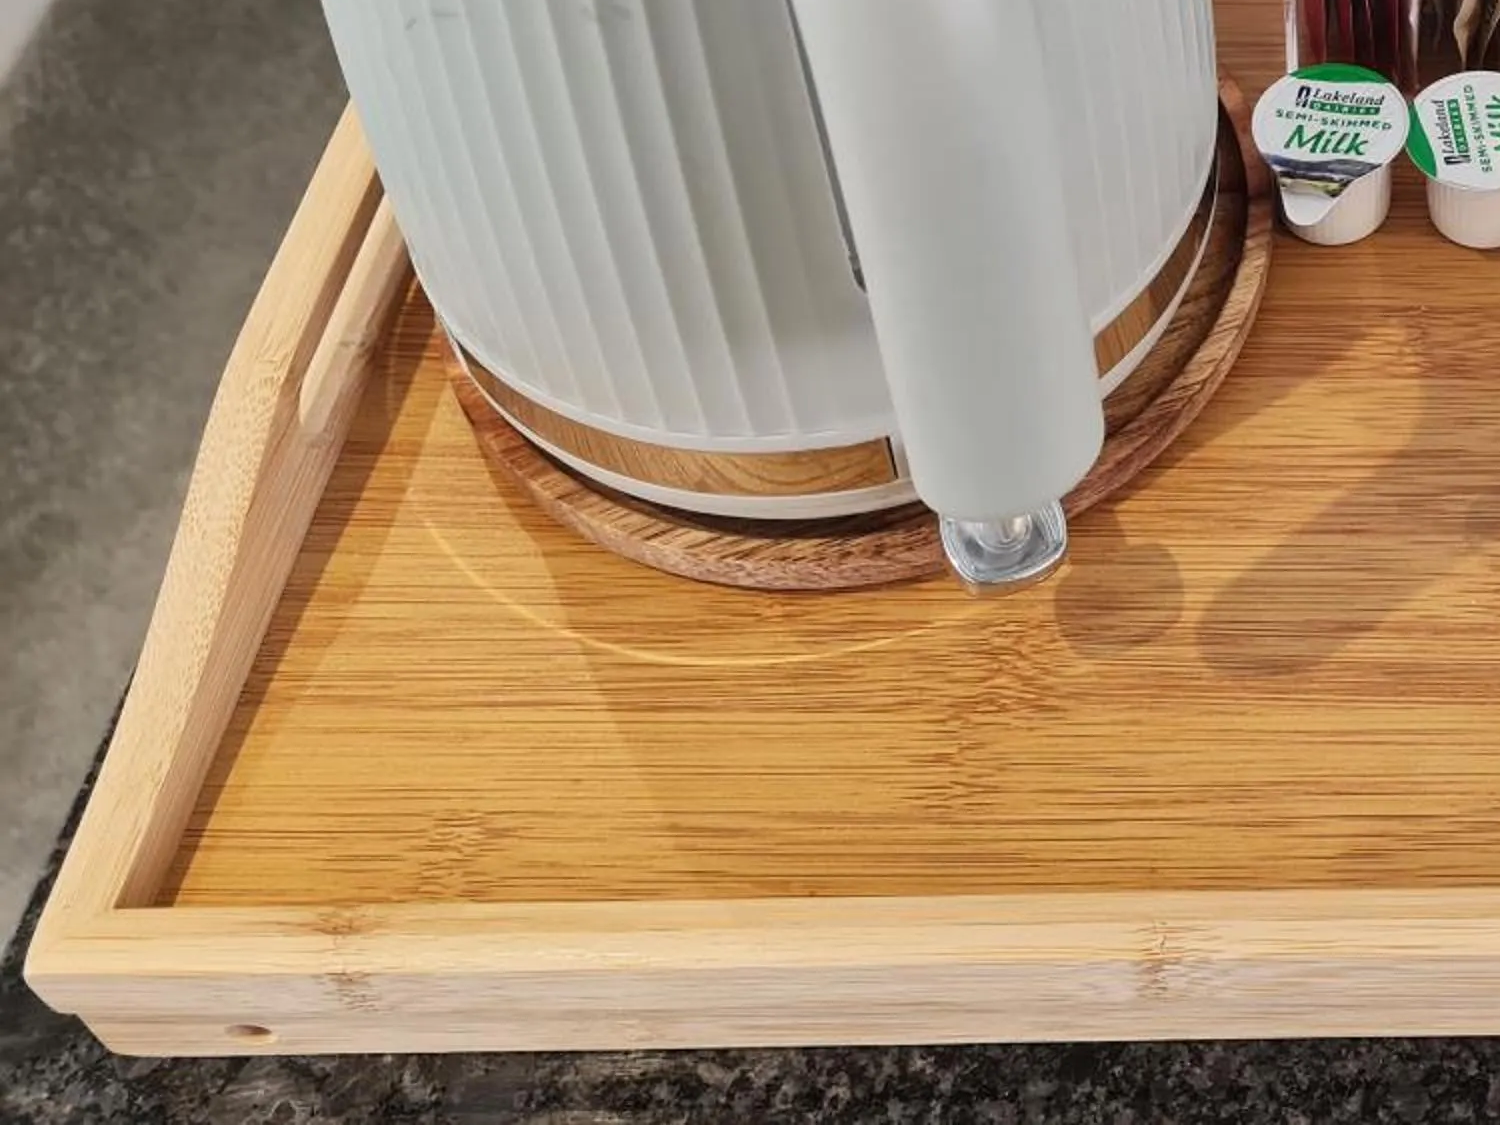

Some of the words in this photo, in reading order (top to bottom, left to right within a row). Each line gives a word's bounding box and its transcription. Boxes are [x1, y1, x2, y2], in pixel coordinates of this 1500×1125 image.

[1313, 87, 1385, 107] Lakeland
[1275, 108, 1392, 131] SEMI-SKIMMED
[1432, 99, 1455, 161] Lakeland
[1464, 84, 1492, 172] SEMI-SKIMMED
[1284, 125, 1370, 156] Milk
